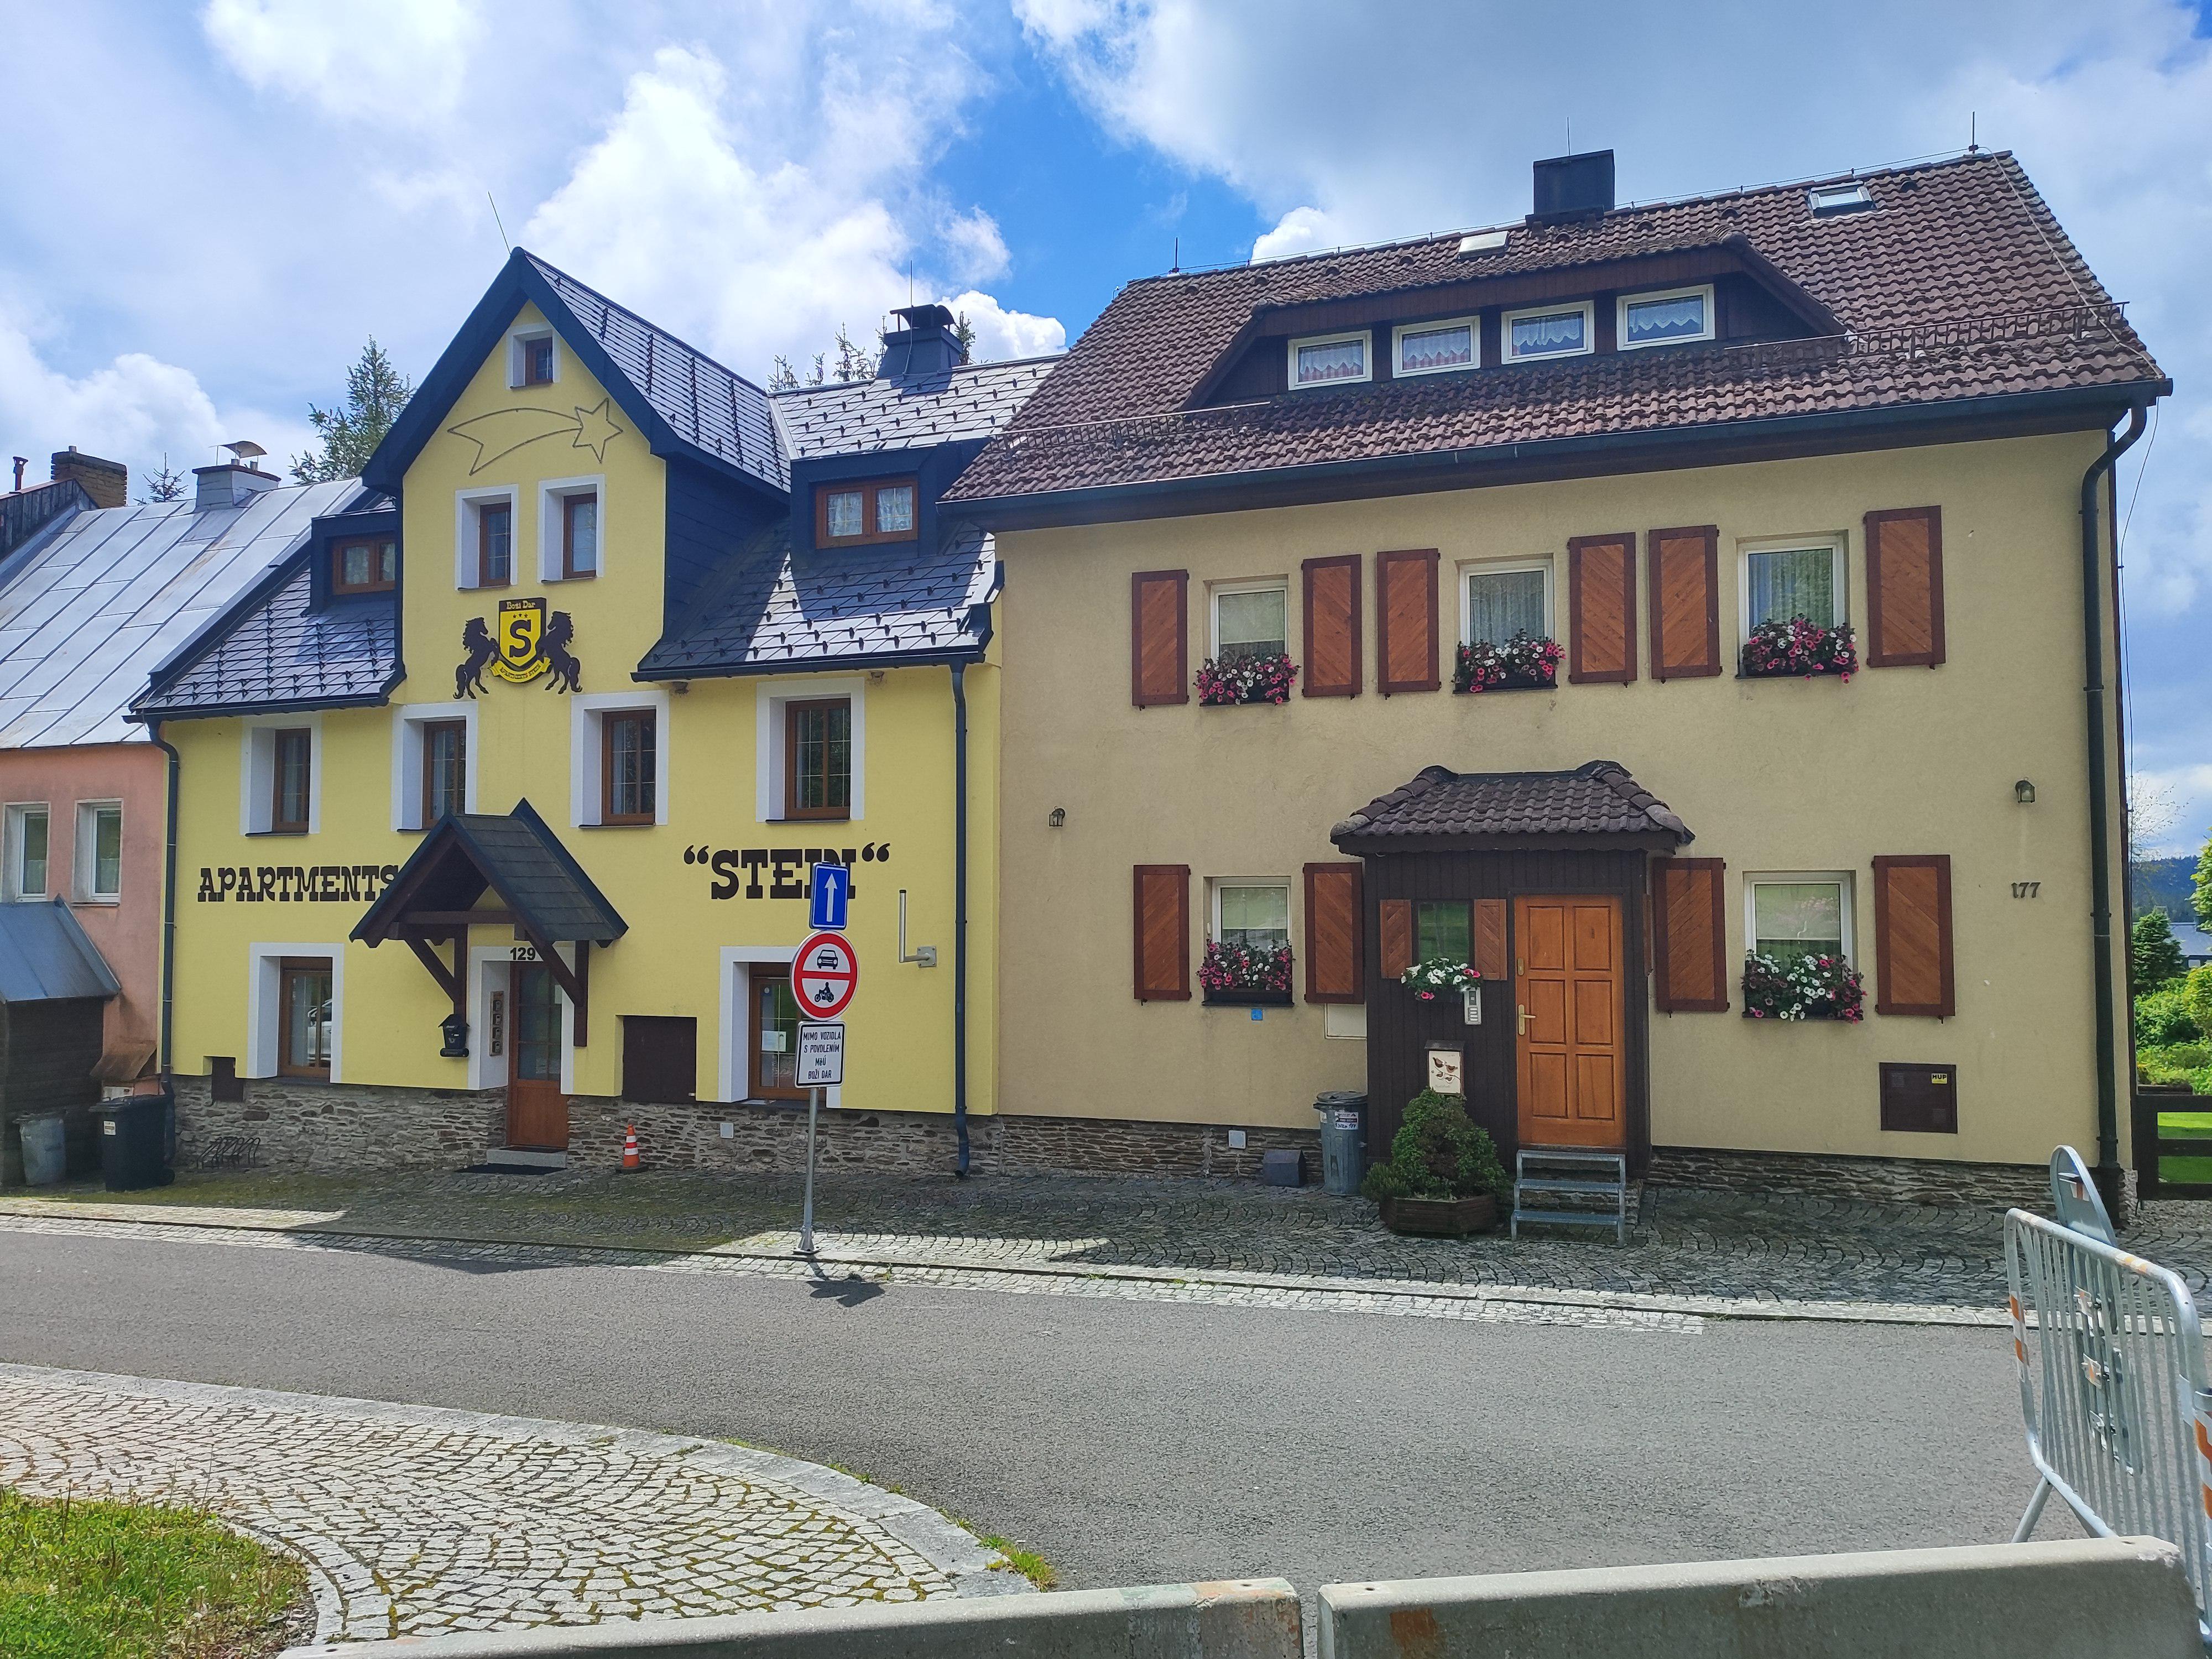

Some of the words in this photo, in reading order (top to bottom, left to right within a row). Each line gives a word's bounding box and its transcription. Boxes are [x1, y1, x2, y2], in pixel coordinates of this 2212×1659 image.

[509, 619, 531, 658] S
[2011, 882, 2041, 898] 177
[510, 947, 536, 960] 129
[803, 1032, 818, 1040] MIMO
[820, 1031, 841, 1040] VOZIDLA
[804, 1045, 808, 1053] S
[810, 1042, 839, 1053] POVOLENÍM
[821, 1070, 832, 1078] DAR
